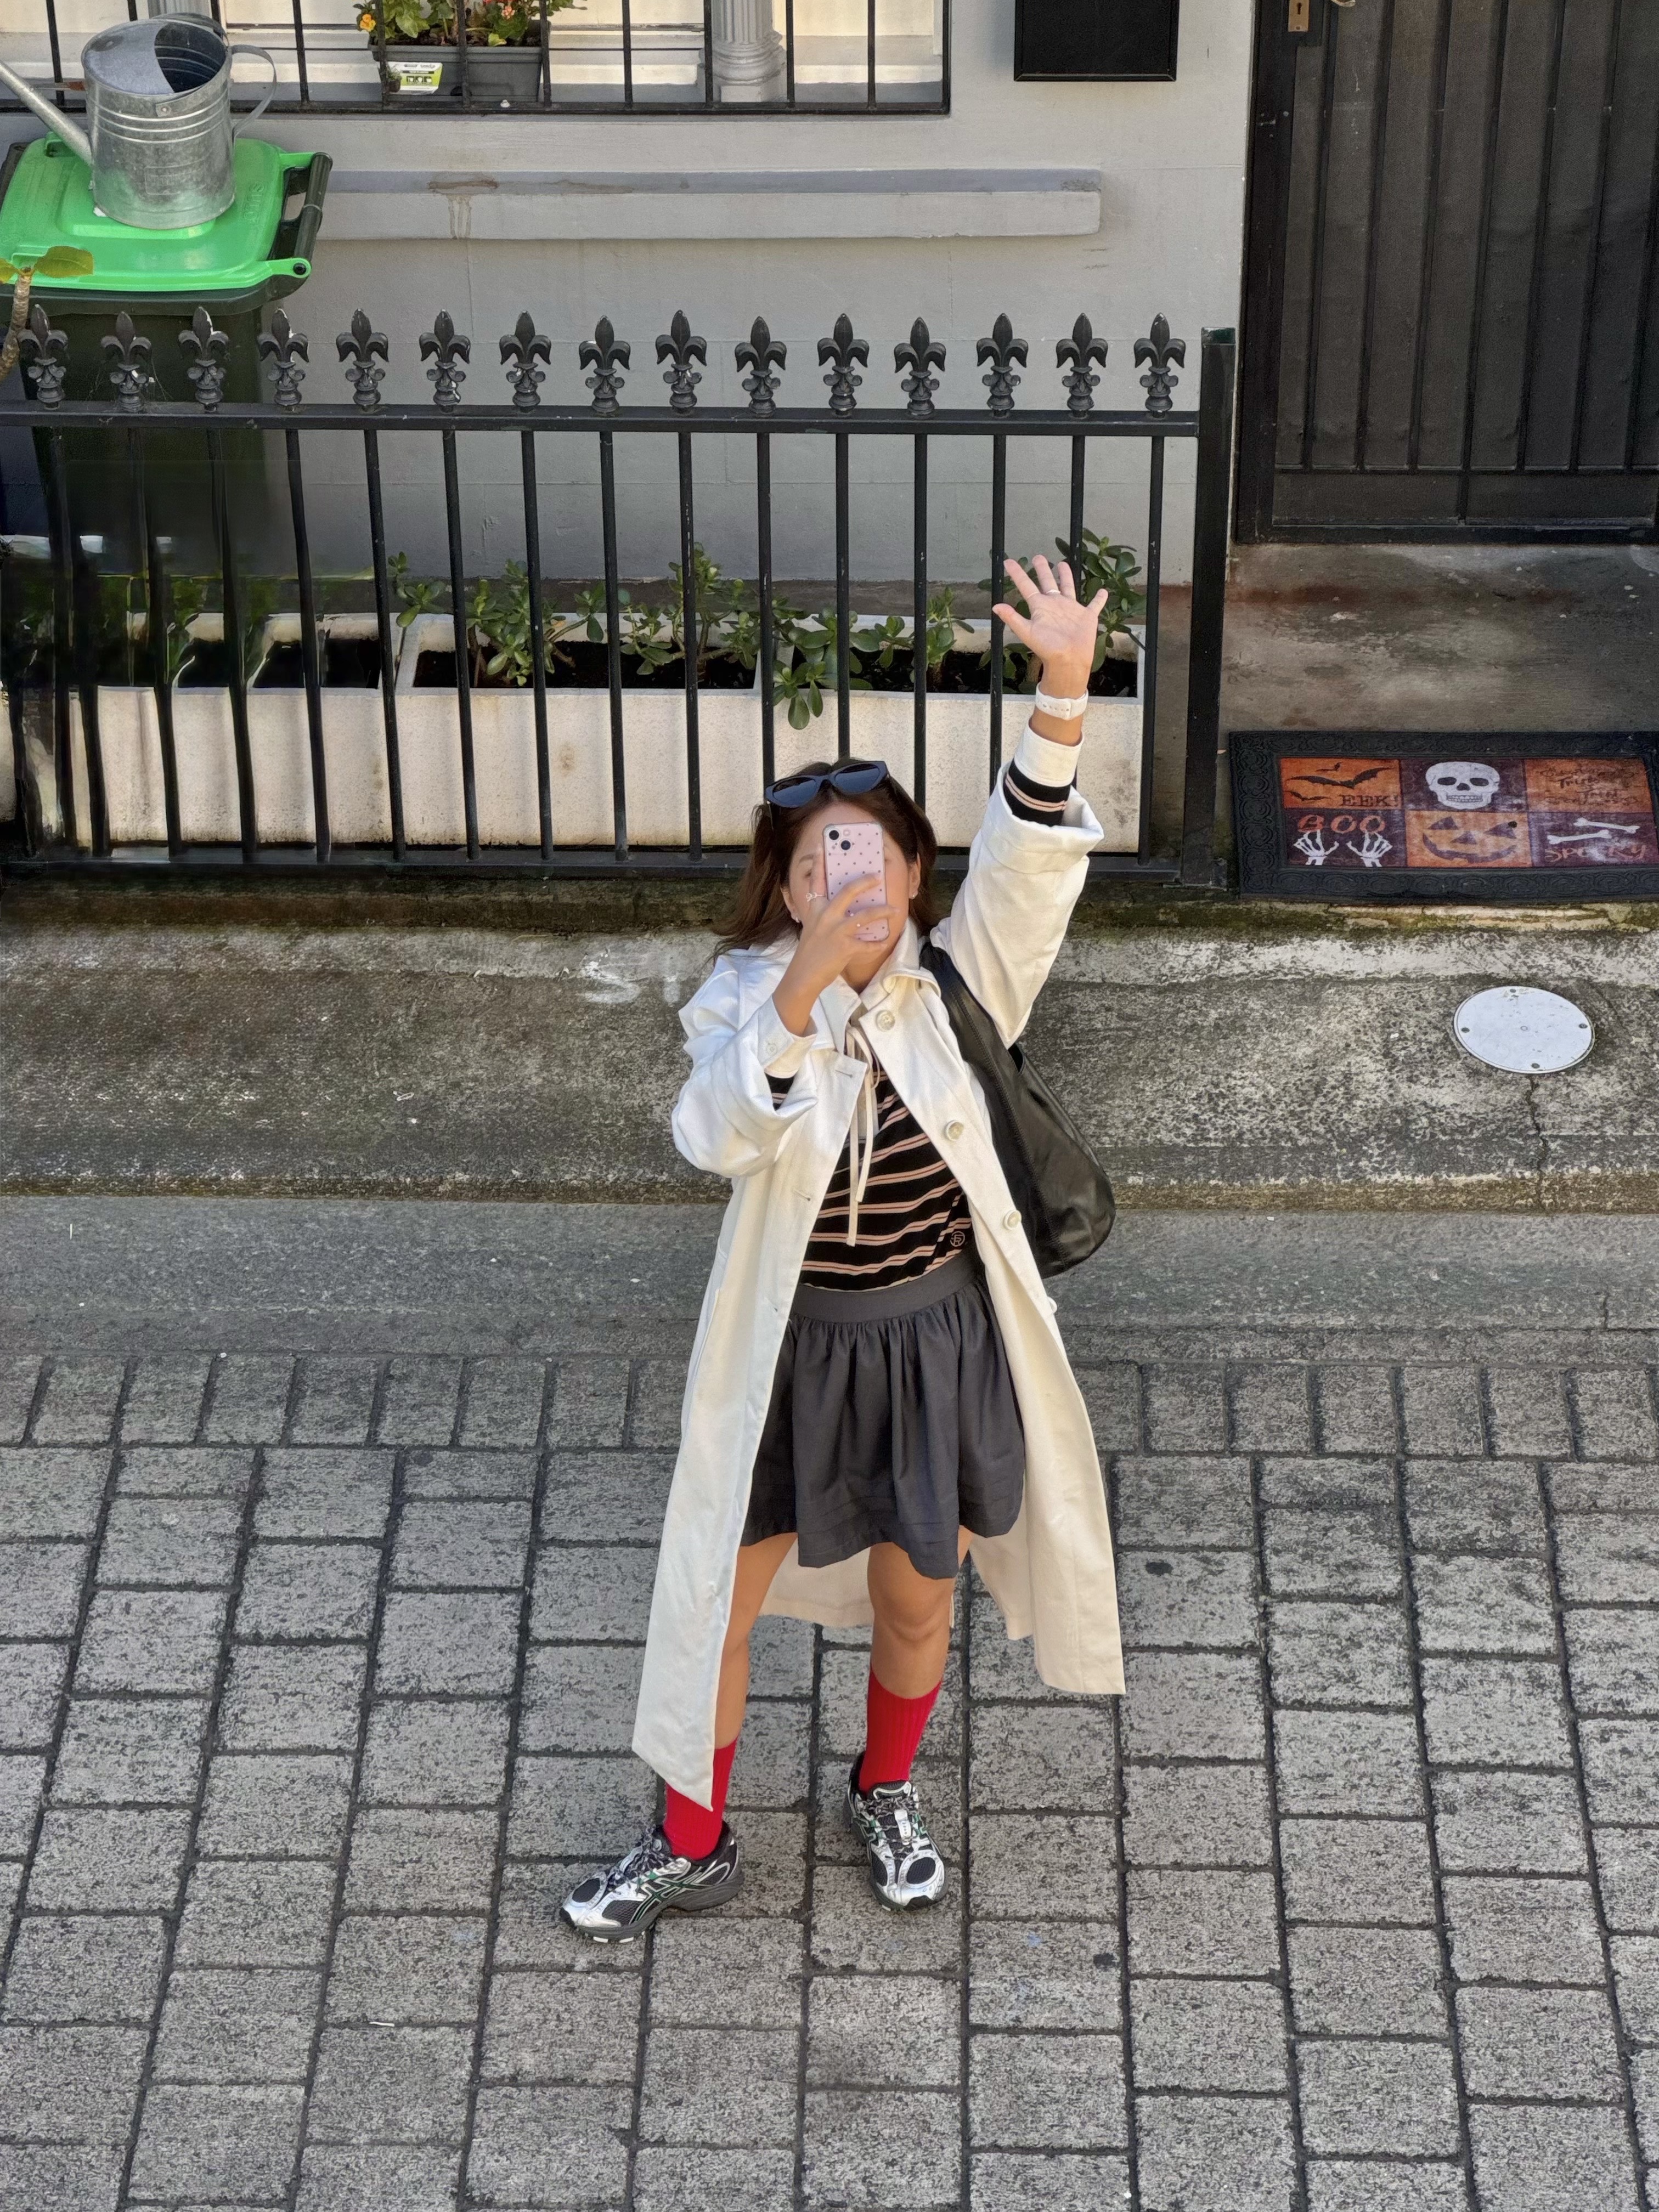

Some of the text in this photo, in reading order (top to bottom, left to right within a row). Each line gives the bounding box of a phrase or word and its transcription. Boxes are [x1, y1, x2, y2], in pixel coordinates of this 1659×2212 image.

[1338, 794, 1399, 807] EEK!
[1297, 814, 1386, 834] BOO
[1544, 845, 1646, 863] SPOKY
